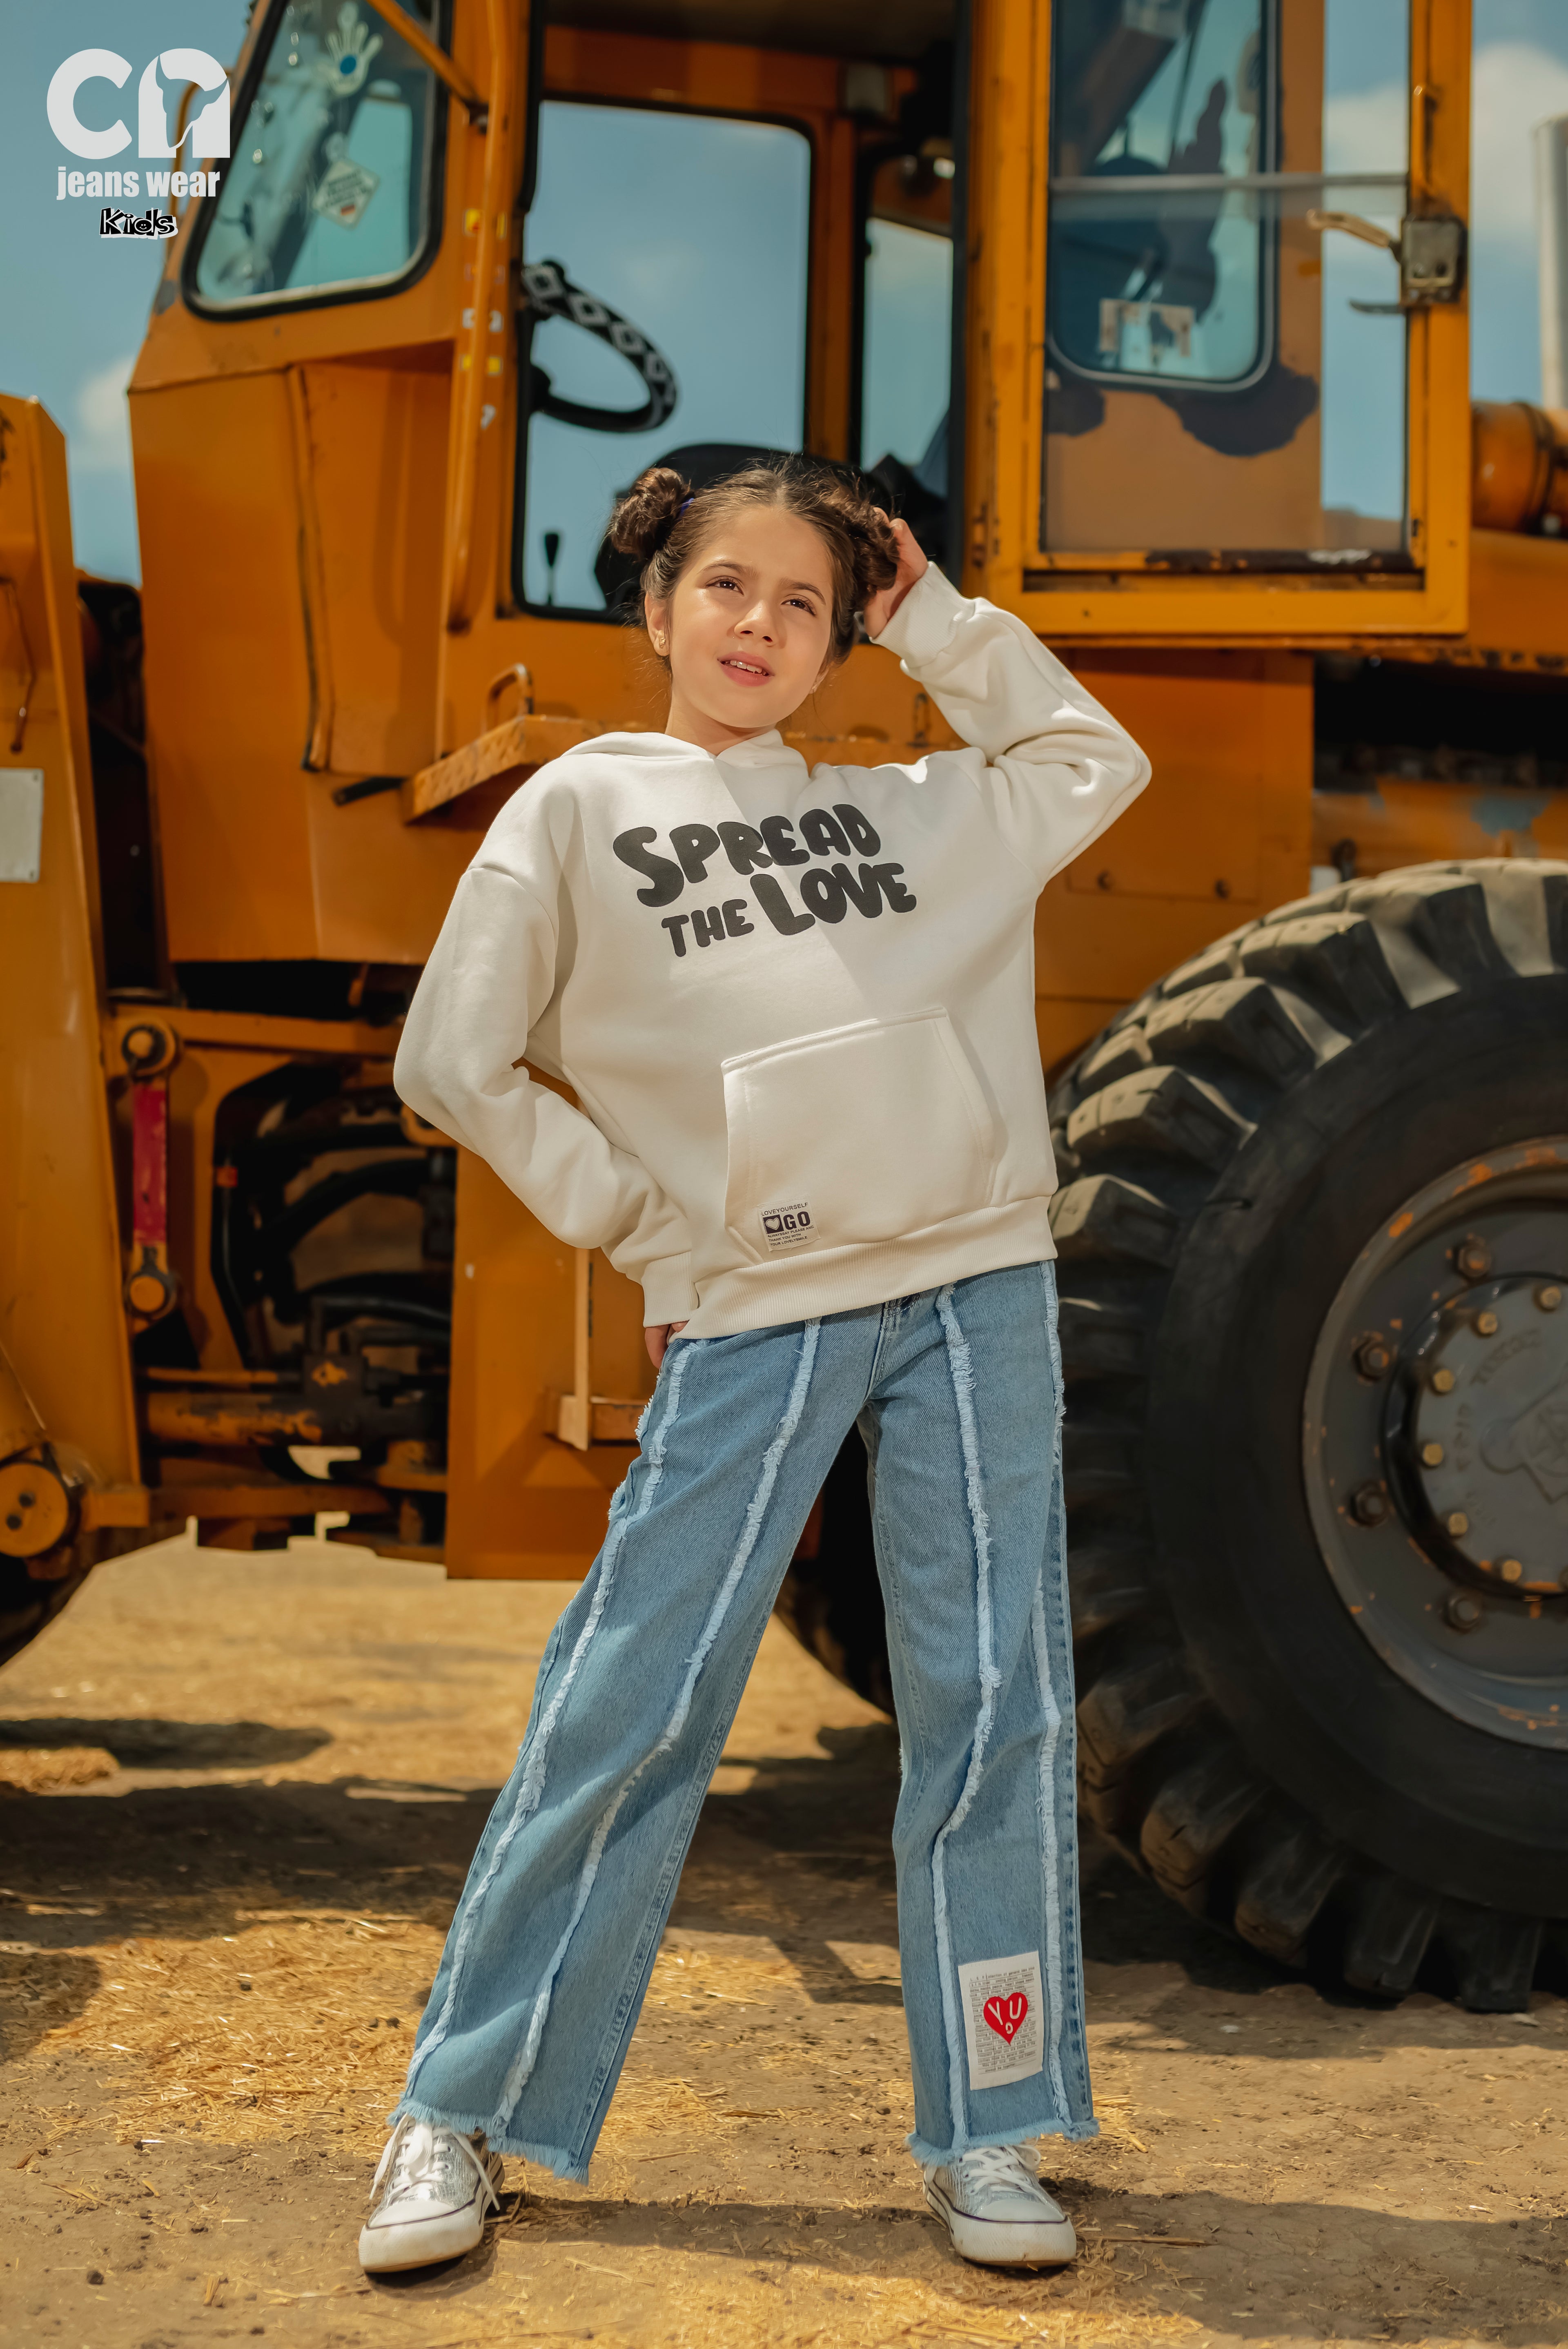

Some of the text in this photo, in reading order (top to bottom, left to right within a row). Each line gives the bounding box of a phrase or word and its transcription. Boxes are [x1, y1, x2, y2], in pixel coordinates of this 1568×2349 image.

[613, 804, 881, 907] SPREAD
[661, 863, 917, 957] THE LOVE
[783, 1211, 811, 1230] GO
